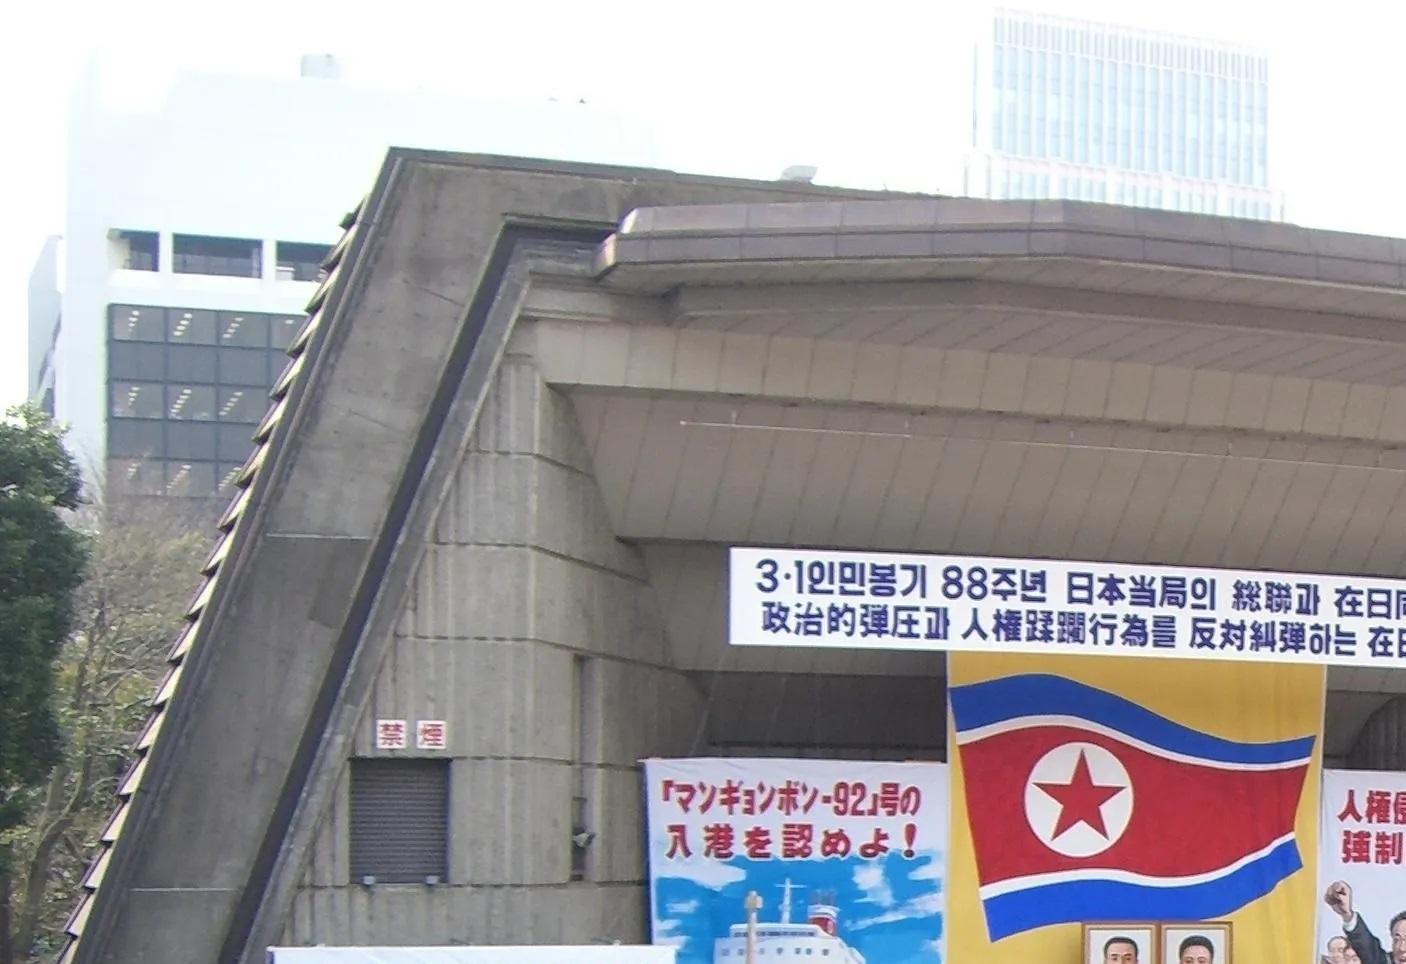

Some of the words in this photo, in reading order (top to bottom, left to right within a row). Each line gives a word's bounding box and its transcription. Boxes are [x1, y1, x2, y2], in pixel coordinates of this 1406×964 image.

[942, 565, 1047, 604] 88주년
[1067, 572, 1216, 611] 日本当局의
[762, 602, 949, 640] 政治的弾圧과
